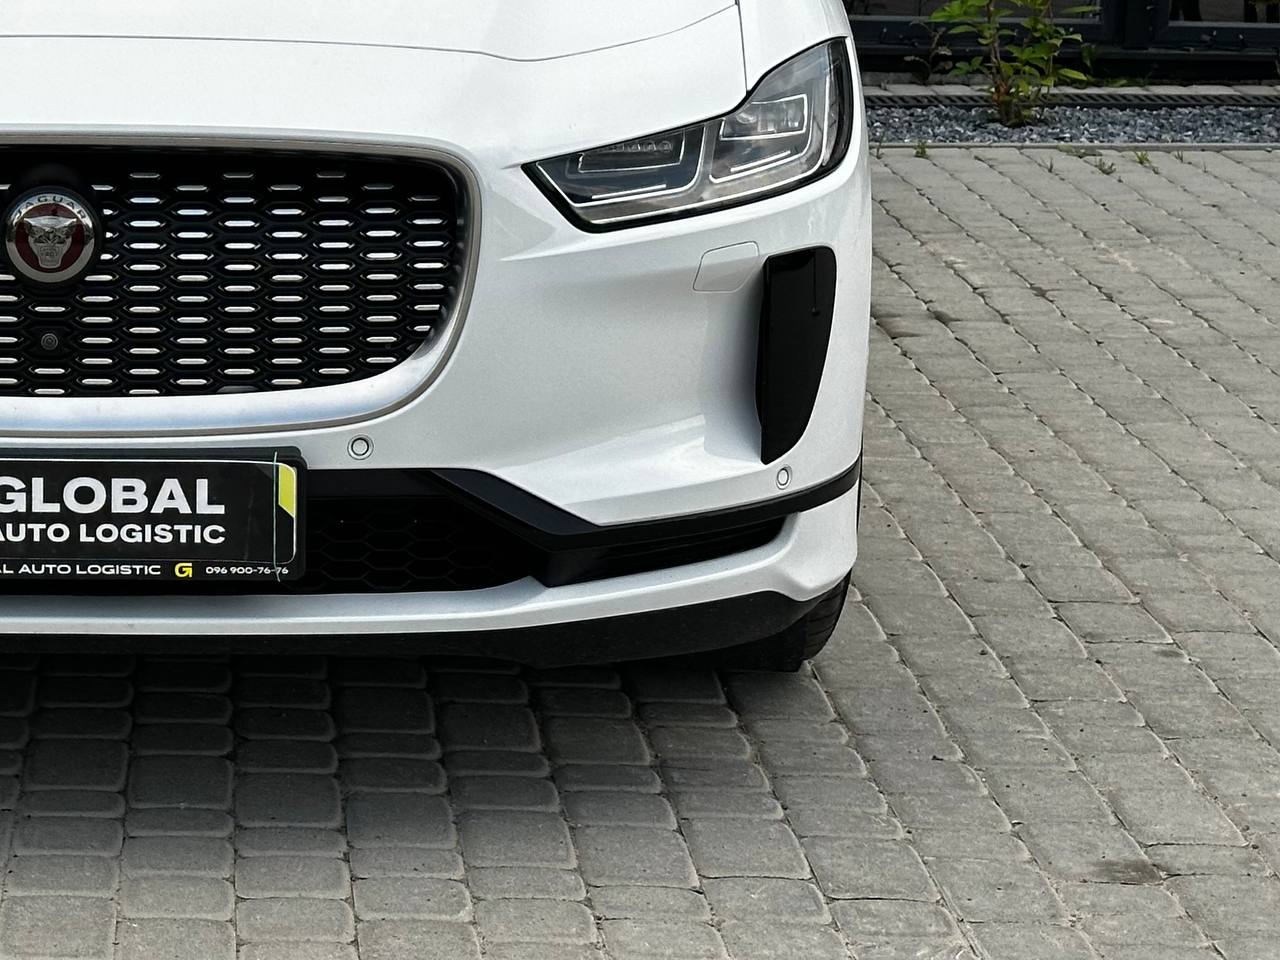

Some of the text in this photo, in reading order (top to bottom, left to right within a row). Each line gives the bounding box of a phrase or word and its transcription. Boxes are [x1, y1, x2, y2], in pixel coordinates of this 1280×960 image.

[16, 195, 88, 220] JAGUAR
[78, 523, 226, 544] LOGISTIC
[18, 563, 72, 575] AUTO
[75, 564, 161, 575] LOGISTIC
[205, 566, 228, 575] 096
